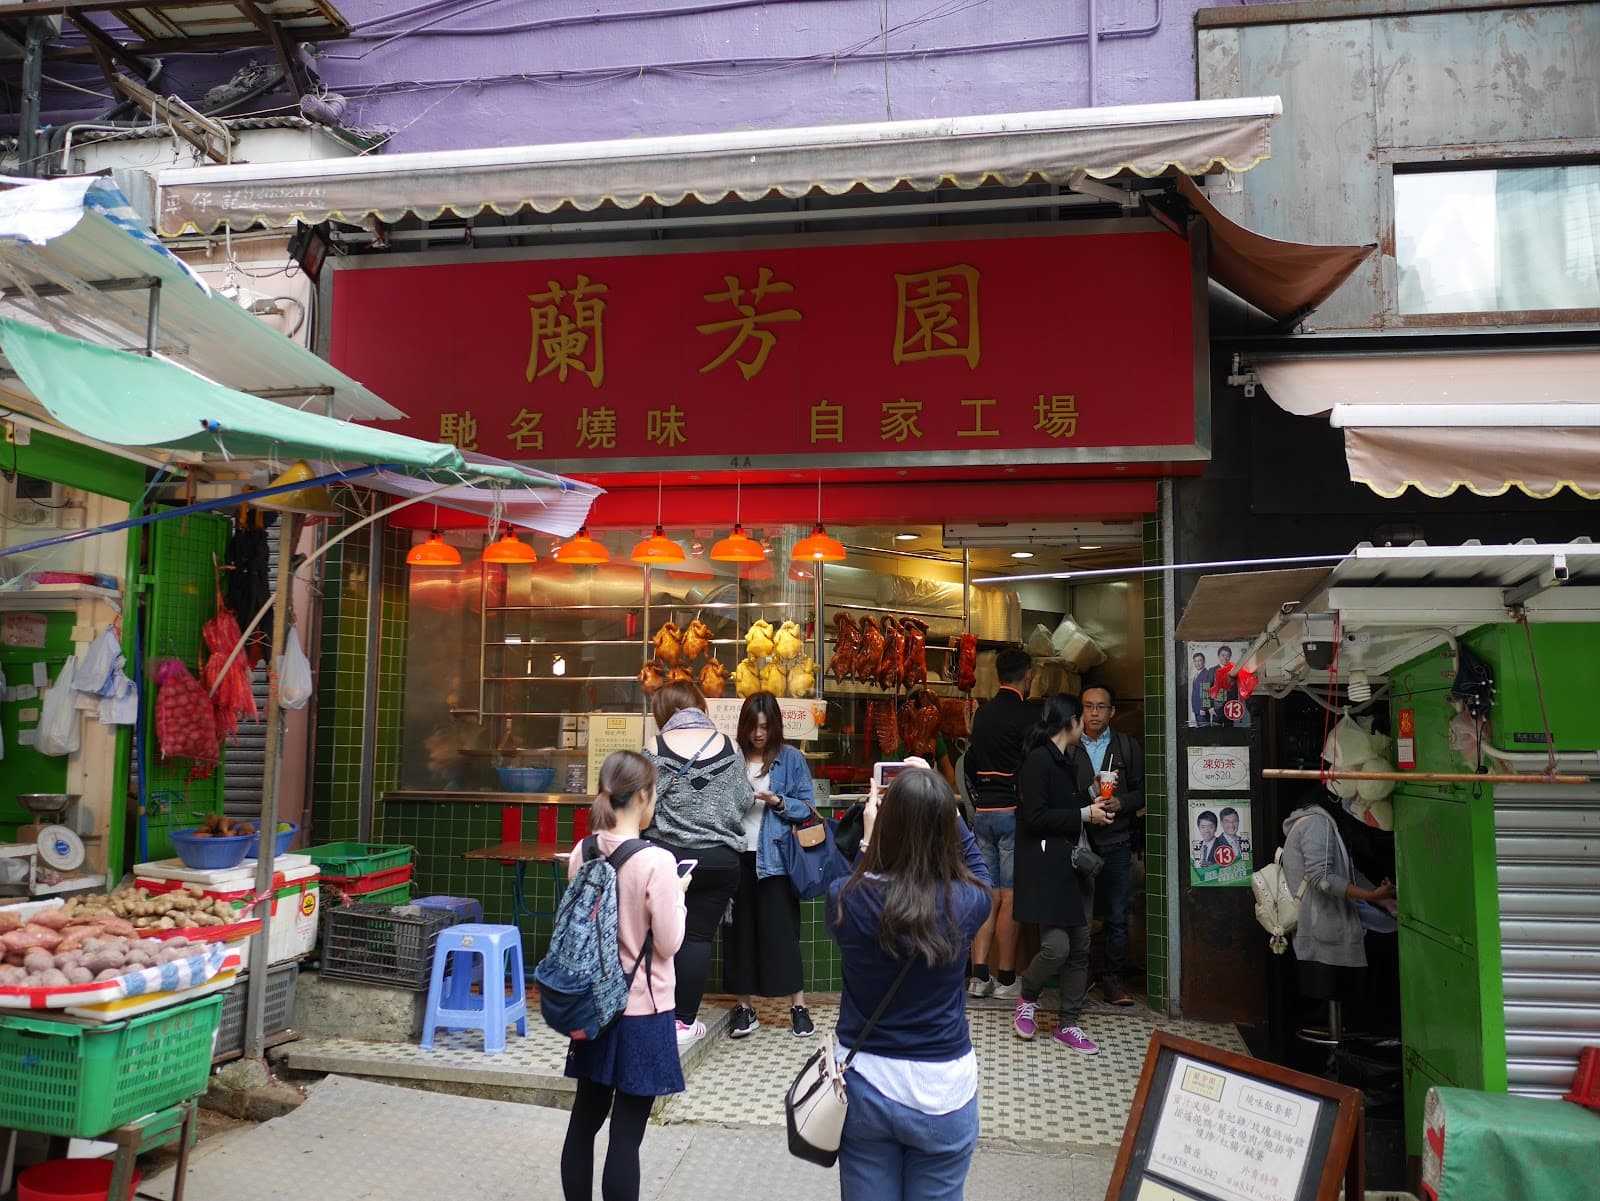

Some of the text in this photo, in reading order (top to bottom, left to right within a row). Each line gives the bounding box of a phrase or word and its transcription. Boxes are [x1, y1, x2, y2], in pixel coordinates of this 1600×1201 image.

[524, 262, 983, 388] 蘭芳園
[439, 394, 1080, 452] 馳名燒味 自家工場
[1227, 702, 1242, 718] 13
[1203, 758, 1236, 770] 凍奶茶
[1216, 848, 1232, 864] 13
